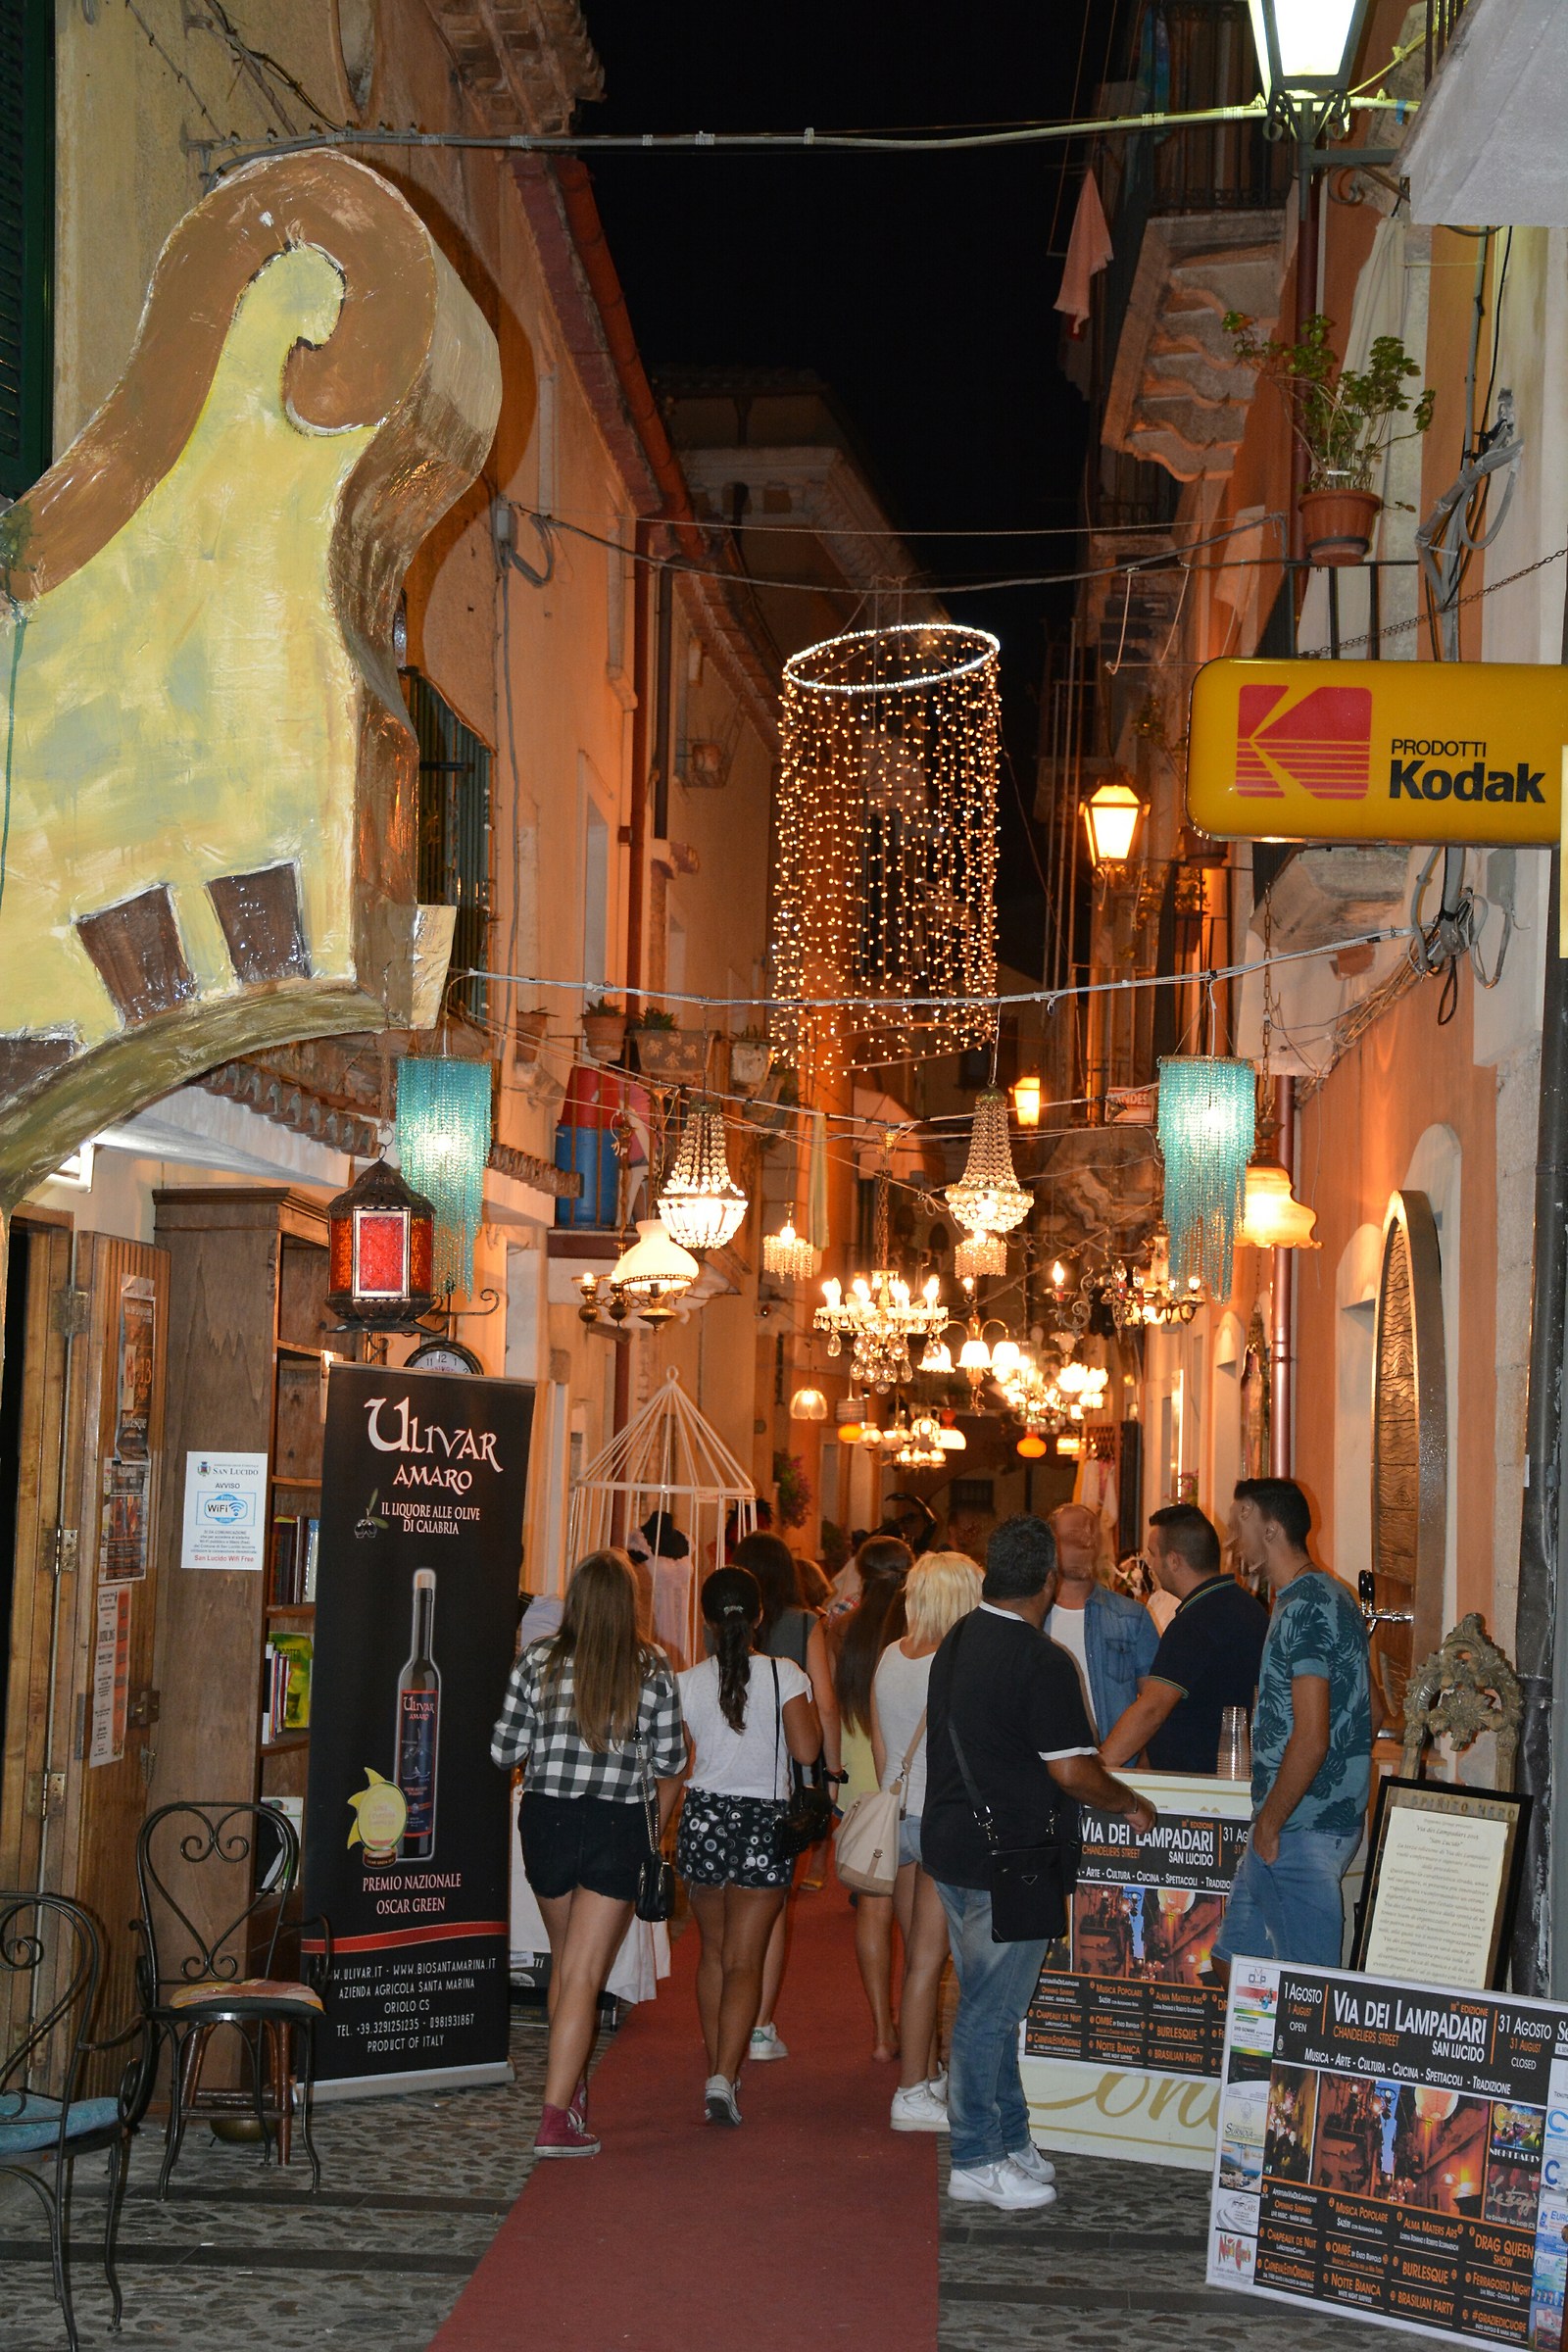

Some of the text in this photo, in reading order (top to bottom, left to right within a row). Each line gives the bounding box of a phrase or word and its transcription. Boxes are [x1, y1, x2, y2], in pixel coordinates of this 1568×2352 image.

[1392, 739, 1487, 758] PRODOTTI
[1390, 760, 1546, 804] Kodak
[439, 1354, 447, 1363] 12
[393, 1464, 472, 1495] AMARO
[207, 1504, 228, 1513] WiFi
[381, 1502, 480, 1521] IL LIQUORE ALLE OLIVE
[403, 1519, 459, 1535] DI CALABRIA
[1082, 1817, 1103, 1843] VIA
[1108, 1824, 1130, 1845] DEI
[1223, 1827, 1234, 1841] 31
[1082, 1844, 1141, 1859] CHANDELIERS STREET
[1168, 1851, 1214, 1867] SAN LUCIDO
[363, 1873, 462, 1891] PREMIO NAZIONALE
[1086, 1867, 1101, 1878] ARTE
[1105, 1868, 1131, 1881] CULTURA
[1137, 1871, 1160, 1884] CUCINA
[1165, 1874, 1198, 1886] SPETTACOLI
[376, 1896, 446, 1914] OSCAR GREEN
[333, 1958, 496, 1981] W.ULIVAR.IT WWW.BIOSANTAMARINA.IT
[338, 1978, 475, 1999] AZIENDA AGRICOLA SANTA MARINA
[1284, 1982, 1322, 2004] 1 AGOSTO
[384, 1999, 430, 2014] ORIOLO CS
[1293, 2004, 1312, 2017] AUGUST
[1460, 2004, 1489, 2017] EDIZIONE
[1334, 1989, 1487, 2045] VIA DEI LAMPADARI
[1497, 2014, 1551, 2039] 31 AGOSTO
[337, 2025, 353, 2037] TEL.
[1156, 2025, 1198, 2040] BURLESQUE
[1289, 2021, 1307, 2033] OPEN
[1333, 2026, 1399, 2047] CHANDELIERS STREET
[368, 2034, 445, 2052] PRODUCT OF ITALY
[1096, 2039, 1116, 2051] NOTTE
[1117, 2041, 1141, 2055] BIANCA
[1432, 2040, 1485, 2063] SAN LUCIDO
[1509, 2038, 1542, 2053] 31 AUGUST
[1153, 2049, 1204, 2064] BRASILIAN PARTY
[1511, 2057, 1537, 2070] CLOSED
[1304, 2048, 1511, 2095] MUSICA ARTE CULTURA CUCINA SPETTACOLI TRADIZIONE
[1336, 2201, 1389, 2224] MUSICA POPOLARE
[1402, 2217, 1421, 2231] ALMA
[1267, 2229, 1317, 2249] CHAPEAUX DE NUIT
[1475, 2233, 1535, 2260] DRAG QUEEN
[1493, 2254, 1514, 2268] SHOW
[1402, 2262, 1448, 2284] BURLESQUE
[1331, 2273, 1352, 2290] NOTTE
[1354, 2278, 1381, 2297] BIANCA
[1472, 2272, 1532, 2296] FERRAGOSTO NIGHT
[1397, 2291, 1454, 2315] BRASILIAN PARTY
[1472, 2309, 1527, 2333] #GRAZIEDICUORE
